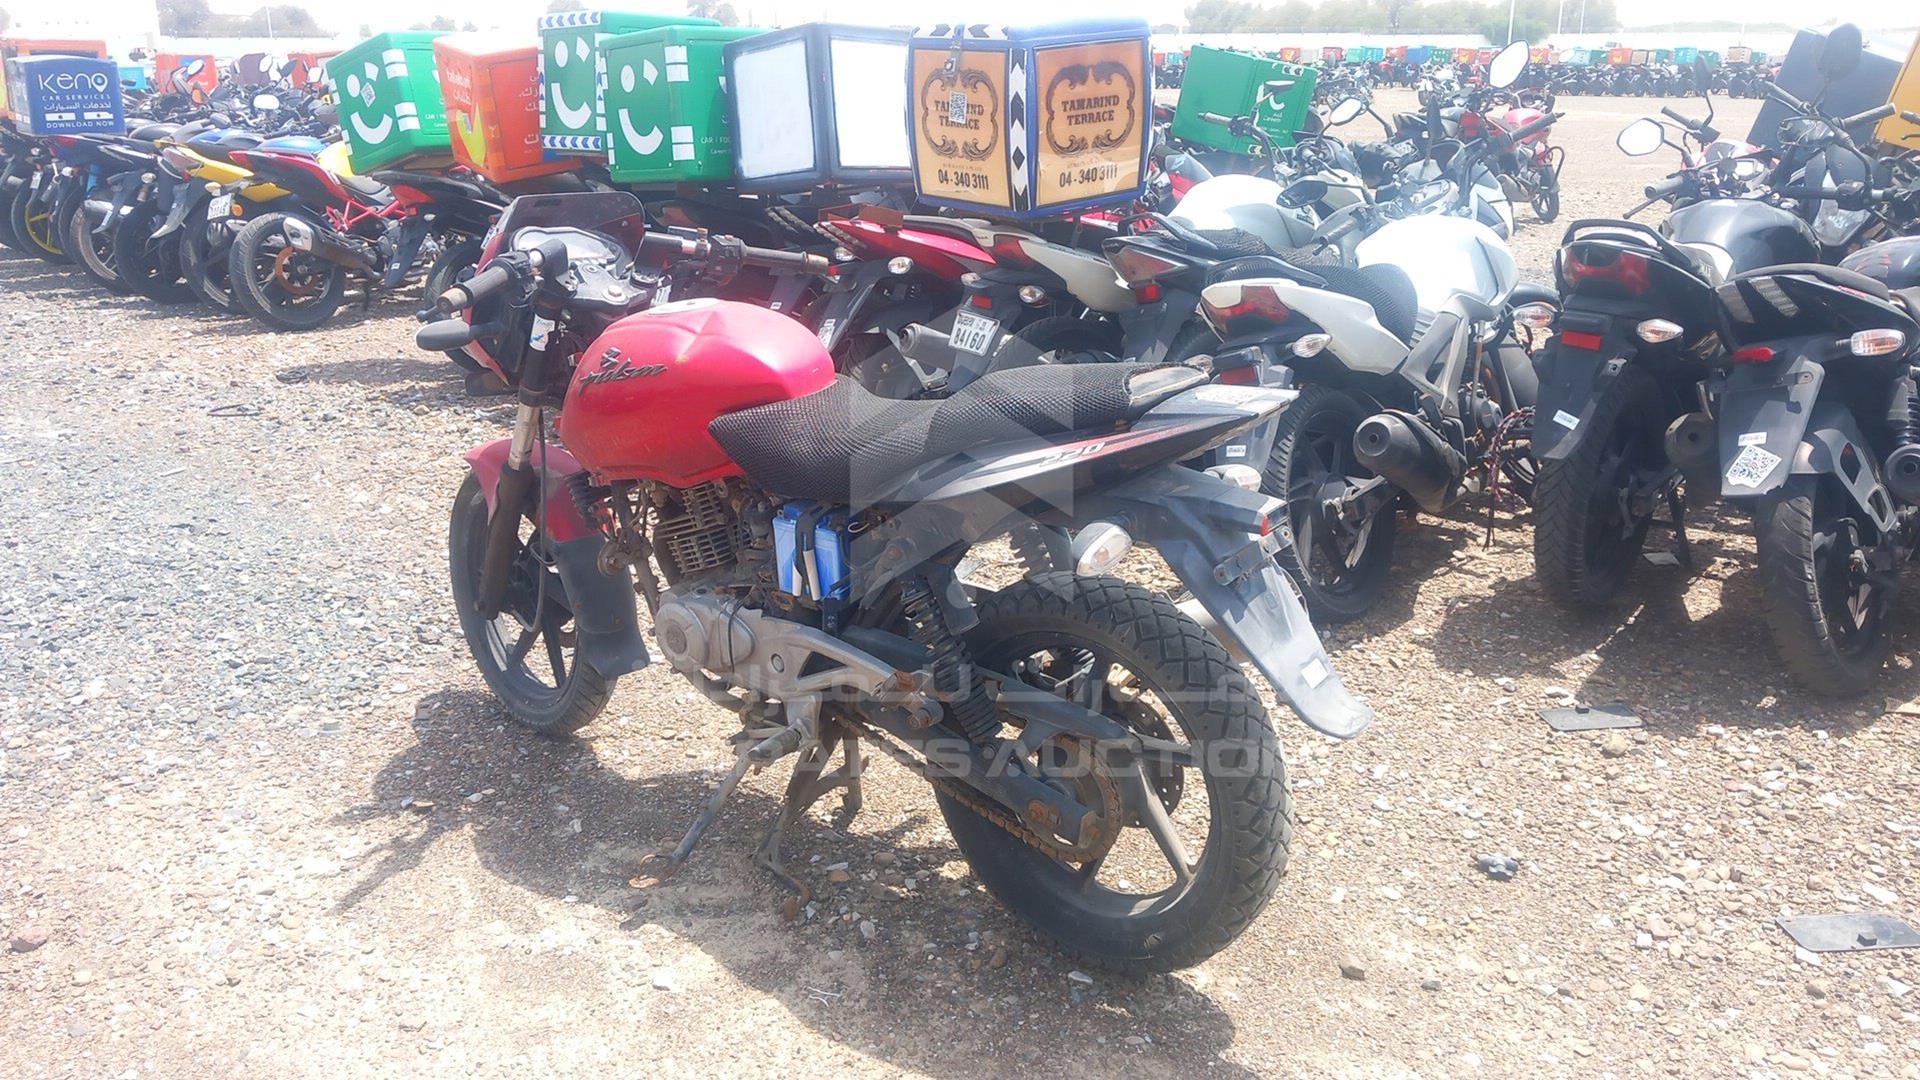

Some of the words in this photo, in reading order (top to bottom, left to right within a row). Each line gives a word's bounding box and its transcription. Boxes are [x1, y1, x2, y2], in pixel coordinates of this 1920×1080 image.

[934, 100, 984, 116] TAIND
[1061, 94, 1120, 112] TAMARIND
[46, 121, 94, 129] DOWNLOAD
[1067, 110, 1115, 126] TERRACE
[972, 173, 989, 190] 3111
[953, 327, 986, 350] 84160
